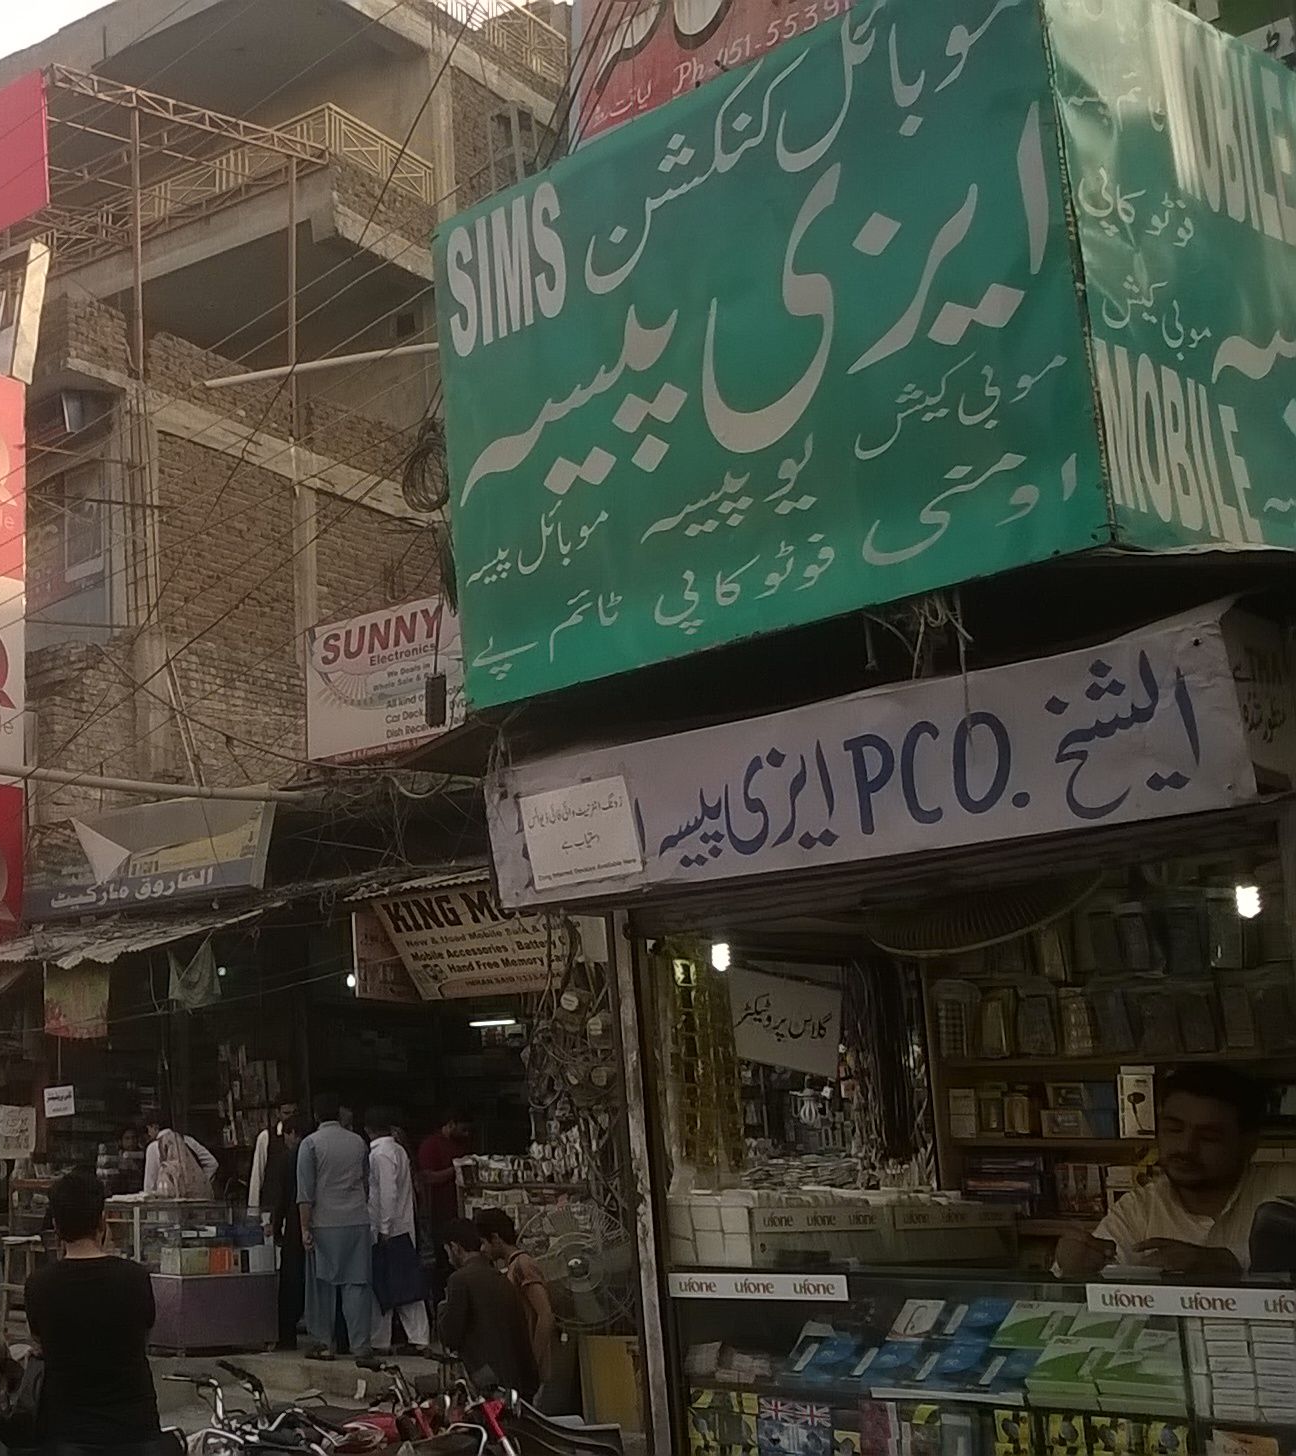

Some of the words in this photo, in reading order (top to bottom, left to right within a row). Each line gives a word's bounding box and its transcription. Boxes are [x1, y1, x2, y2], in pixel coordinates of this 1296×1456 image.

[447, 181, 566, 357] SIMS
[702, 101, 1048, 453] ایزی
[461, 301, 688, 507] پیسہ
[1093, 336, 1263, 543] MOBILE
[321, 605, 442, 666] SUNNY
[370, 642, 436, 667] Electronics
[381, 895, 464, 934] KING
[410, 950, 445, 962] Mobile
[516, 938, 557, 951] Battey
[447, 961, 475, 974] Hand
[476, 959, 500, 971] Free
[500, 954, 545, 968] Memory
[1264, 1294, 1296, 1314] ufo
